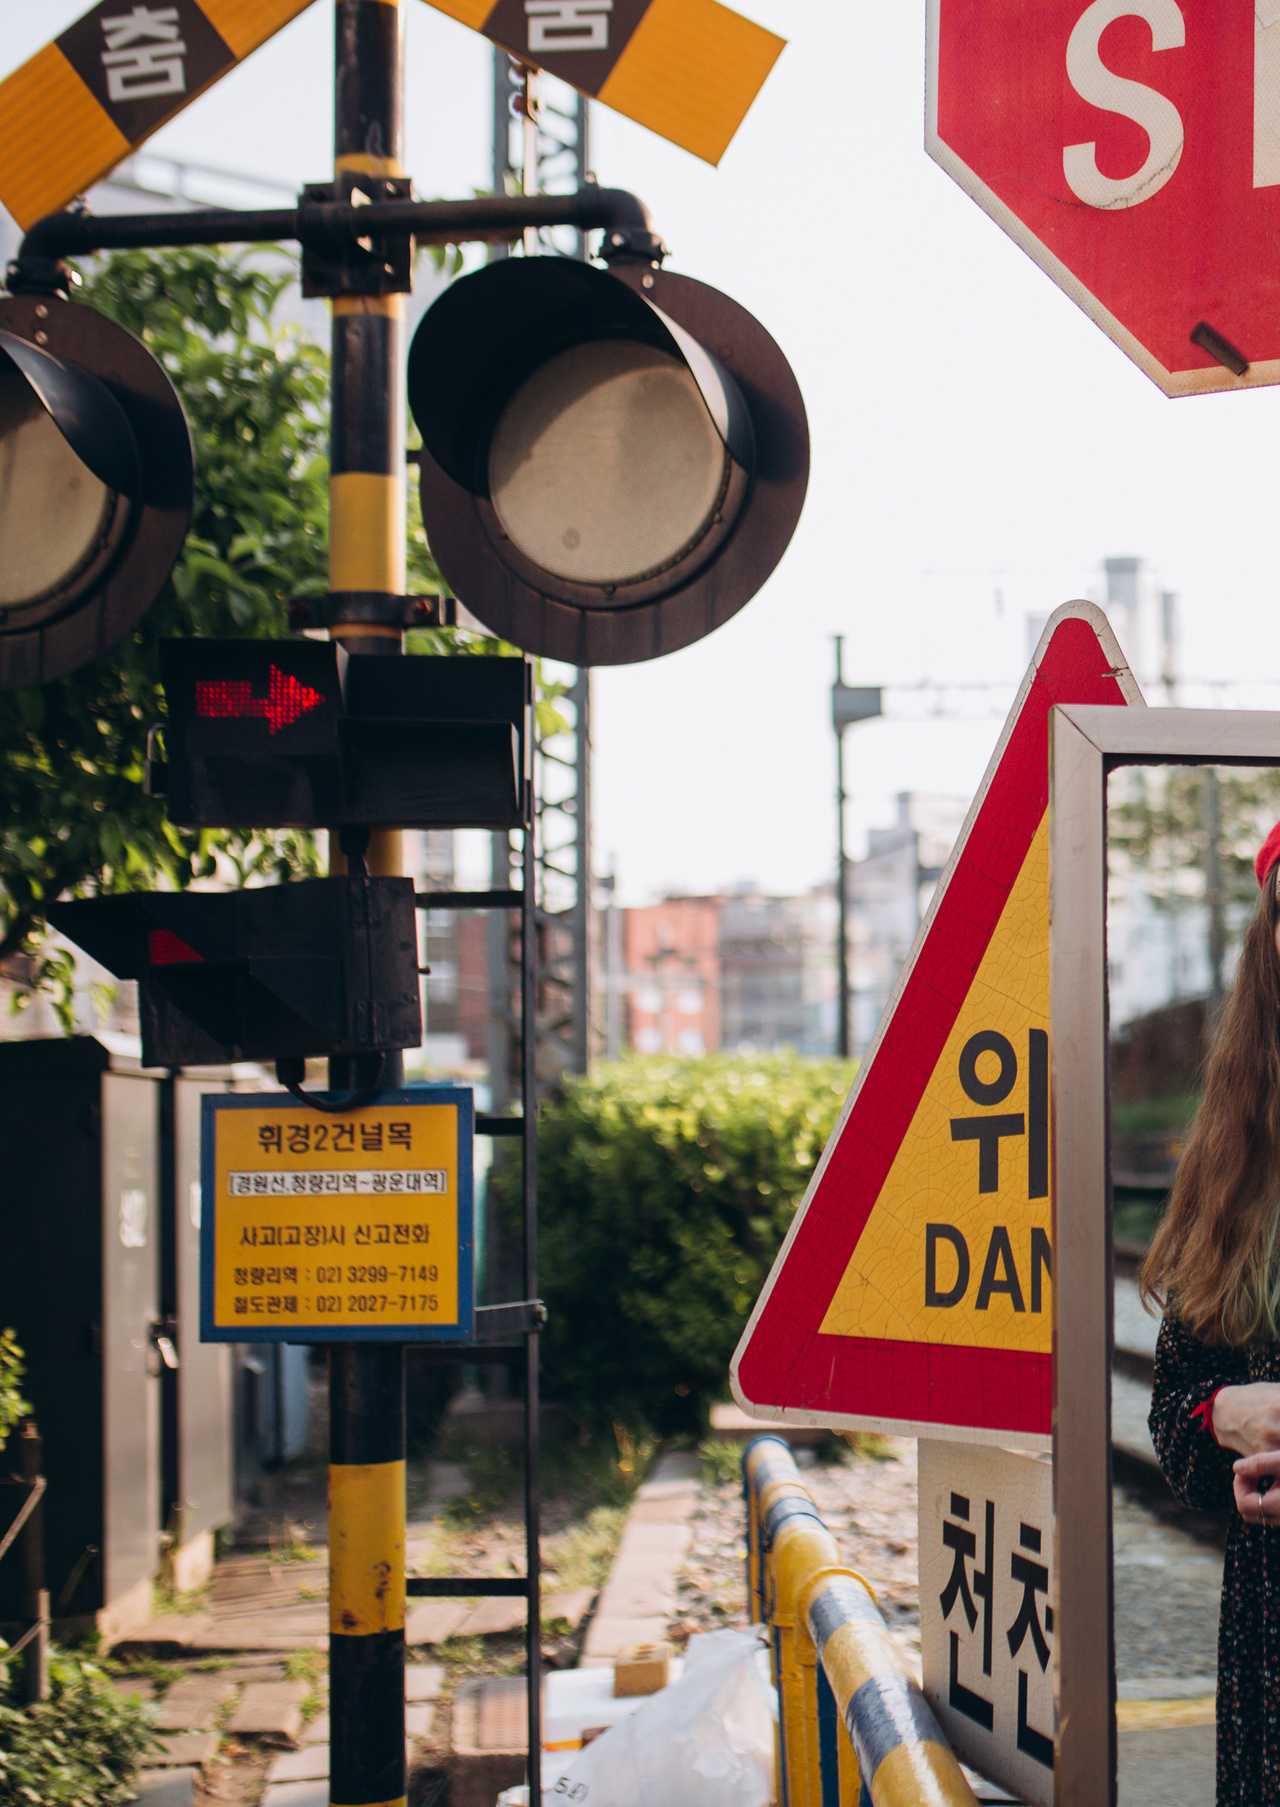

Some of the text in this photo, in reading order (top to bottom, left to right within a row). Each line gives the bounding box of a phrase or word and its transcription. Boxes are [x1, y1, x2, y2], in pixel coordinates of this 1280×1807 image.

[100, 4, 187, 103] 춤
[950, 1027, 1049, 1200] 위
[257, 1122, 413, 1154] 휘경2건널목
[353, 1223, 431, 1246] 신고전화
[233, 1266, 298, 1286] 청량리역
[347, 1264, 439, 1284] 3299-7149
[347, 1294, 439, 1313] 2027-7175
